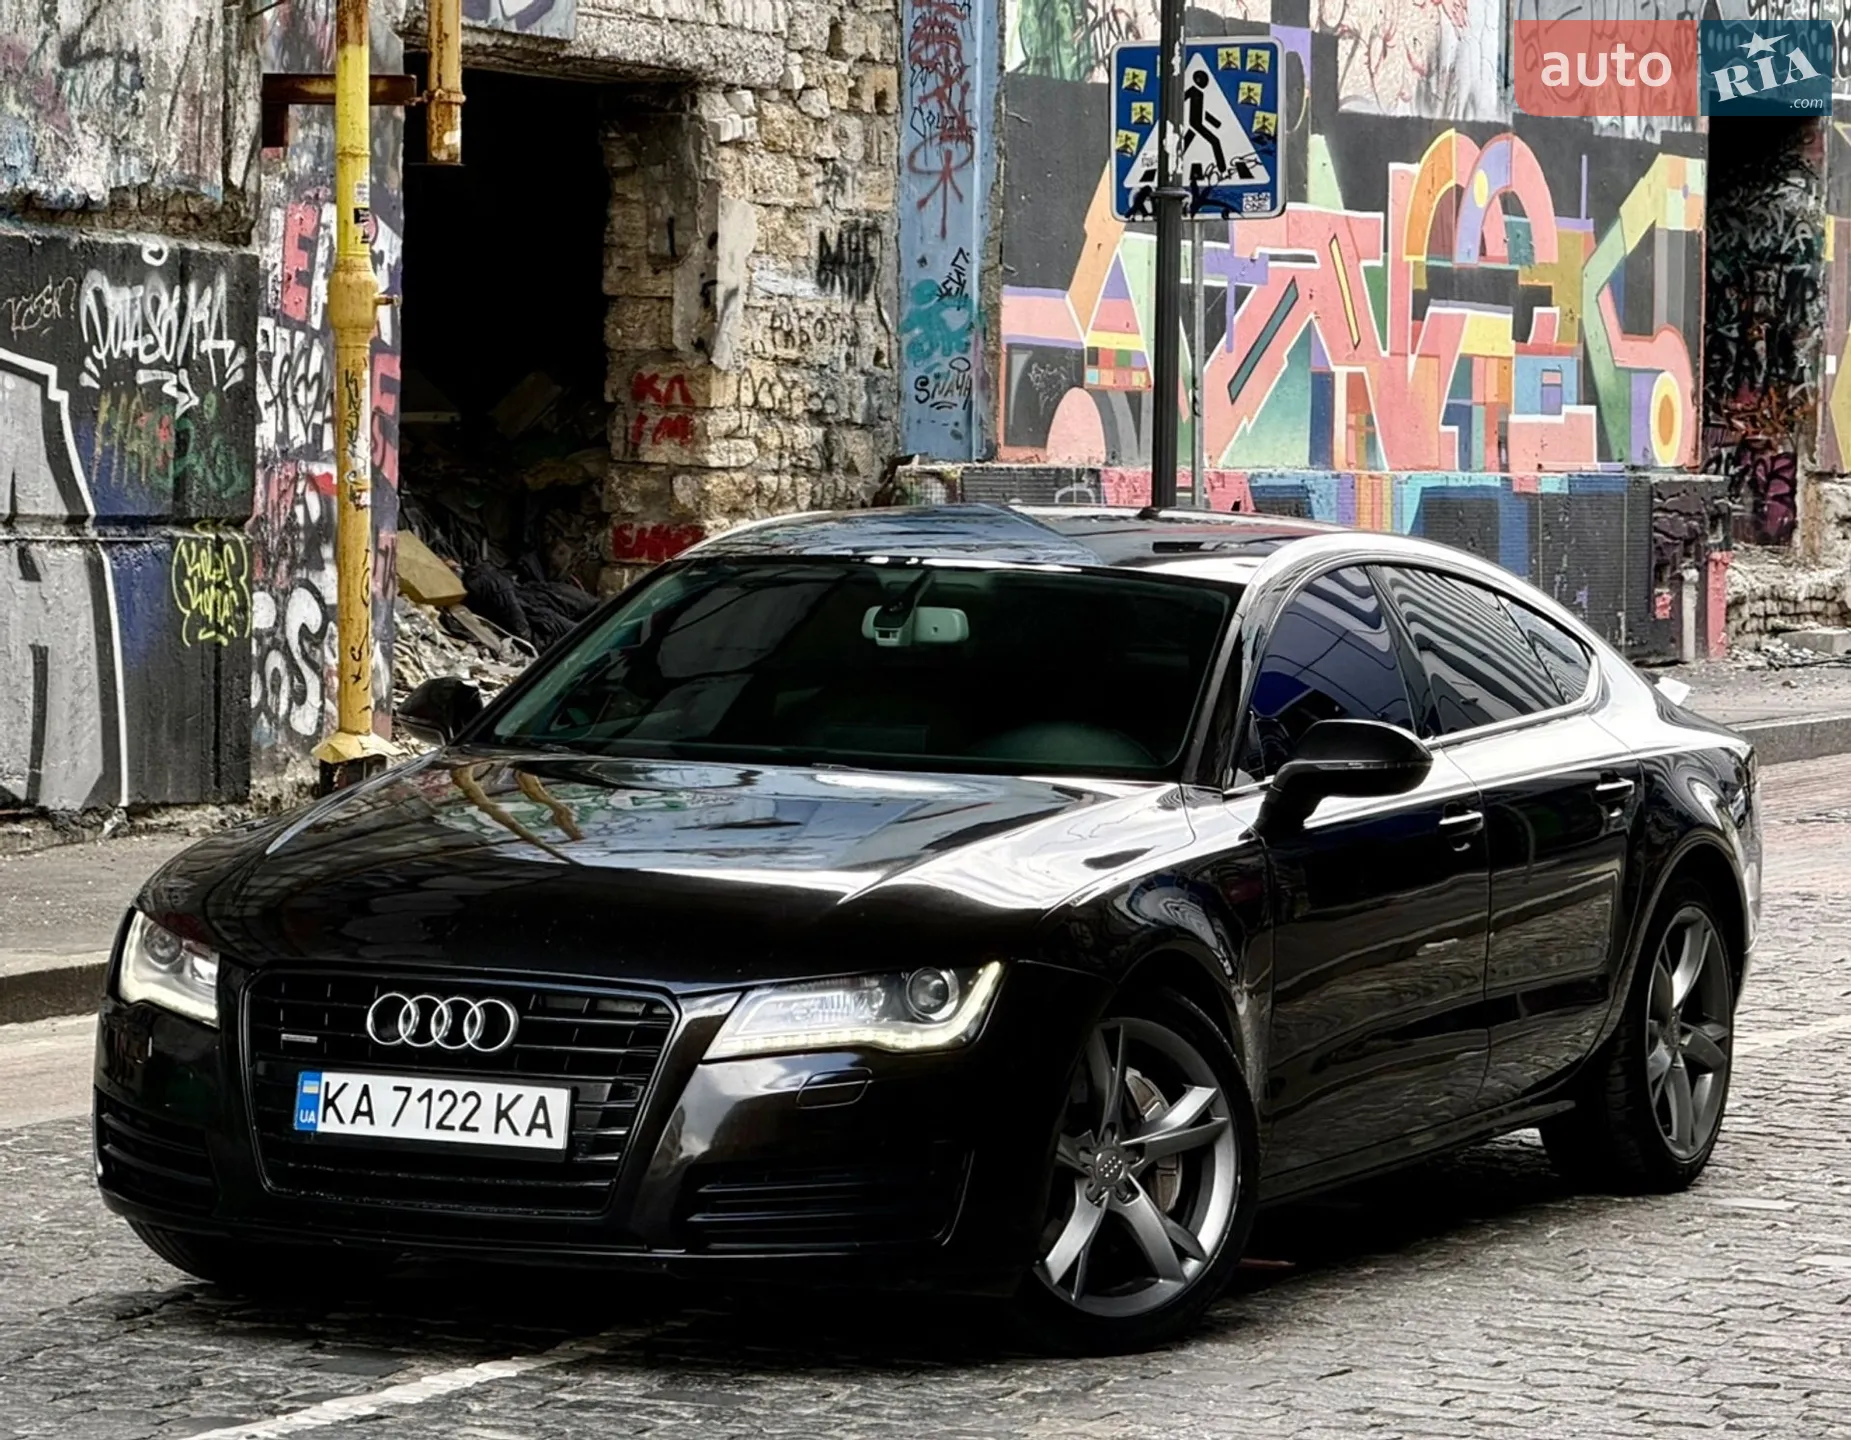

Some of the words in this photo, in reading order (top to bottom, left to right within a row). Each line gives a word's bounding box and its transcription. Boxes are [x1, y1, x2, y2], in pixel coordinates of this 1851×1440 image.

[299, 1109, 317, 1124] UA
[321, 1081, 376, 1126] KA
[391, 1085, 482, 1133] 7122
[493, 1092, 554, 1139] KA
